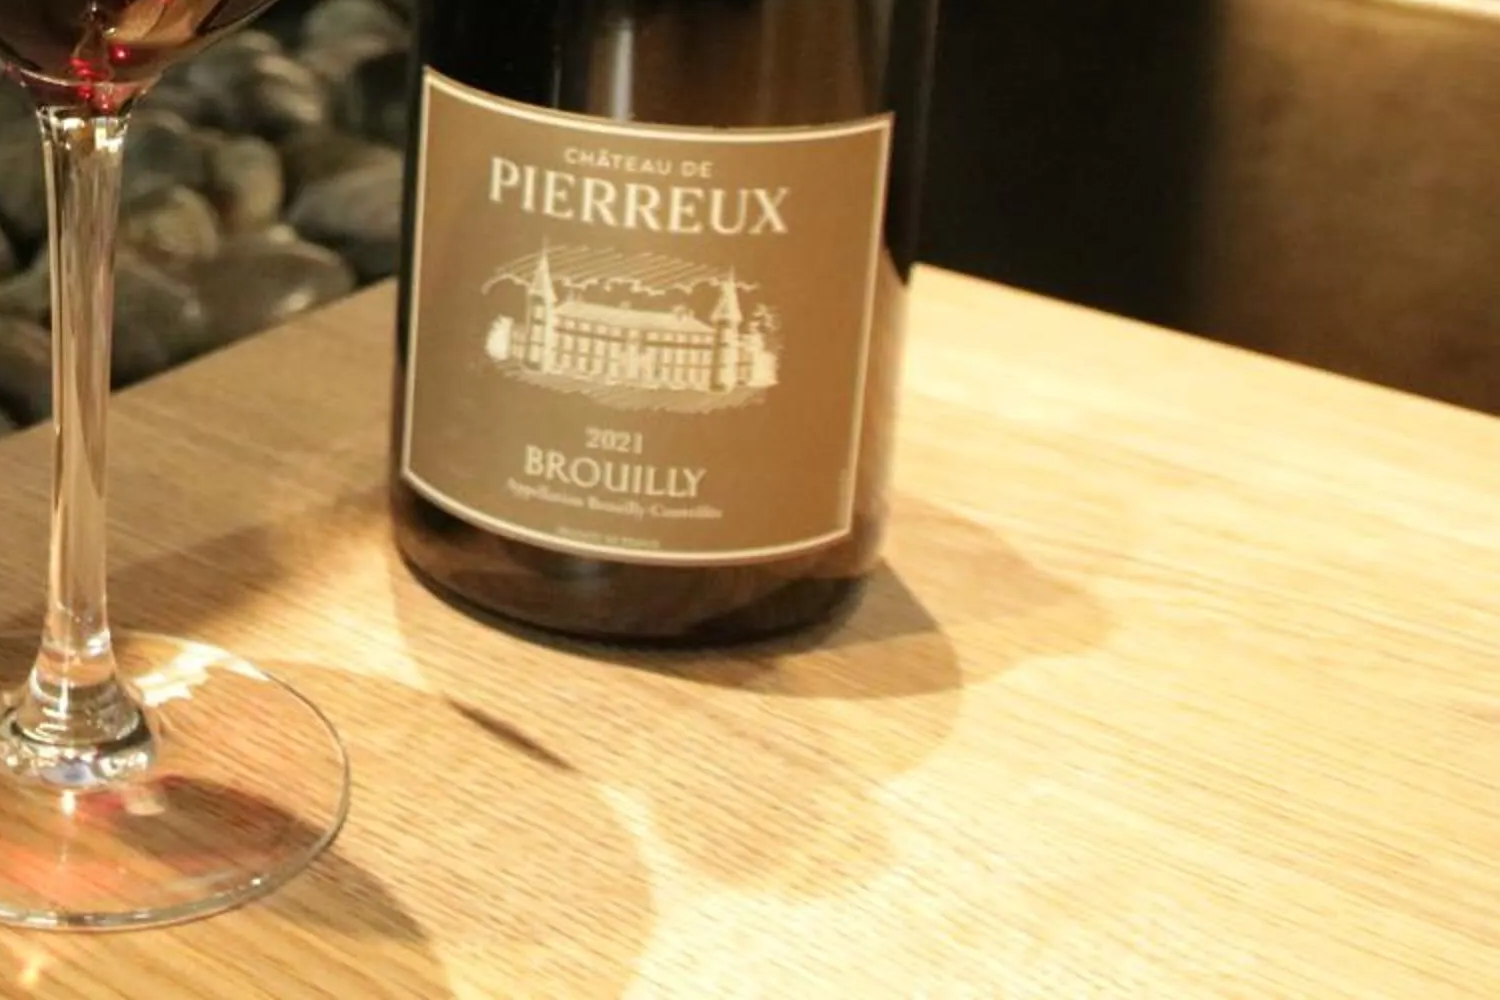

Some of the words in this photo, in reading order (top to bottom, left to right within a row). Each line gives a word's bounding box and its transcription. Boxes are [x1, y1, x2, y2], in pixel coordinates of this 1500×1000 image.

[564, 147, 671, 176] CHÂTEAU
[681, 160, 713, 178] DE
[488, 156, 790, 234] PIERREUX
[585, 427, 643, 454] 2021
[524, 444, 707, 498] BROUILLY
